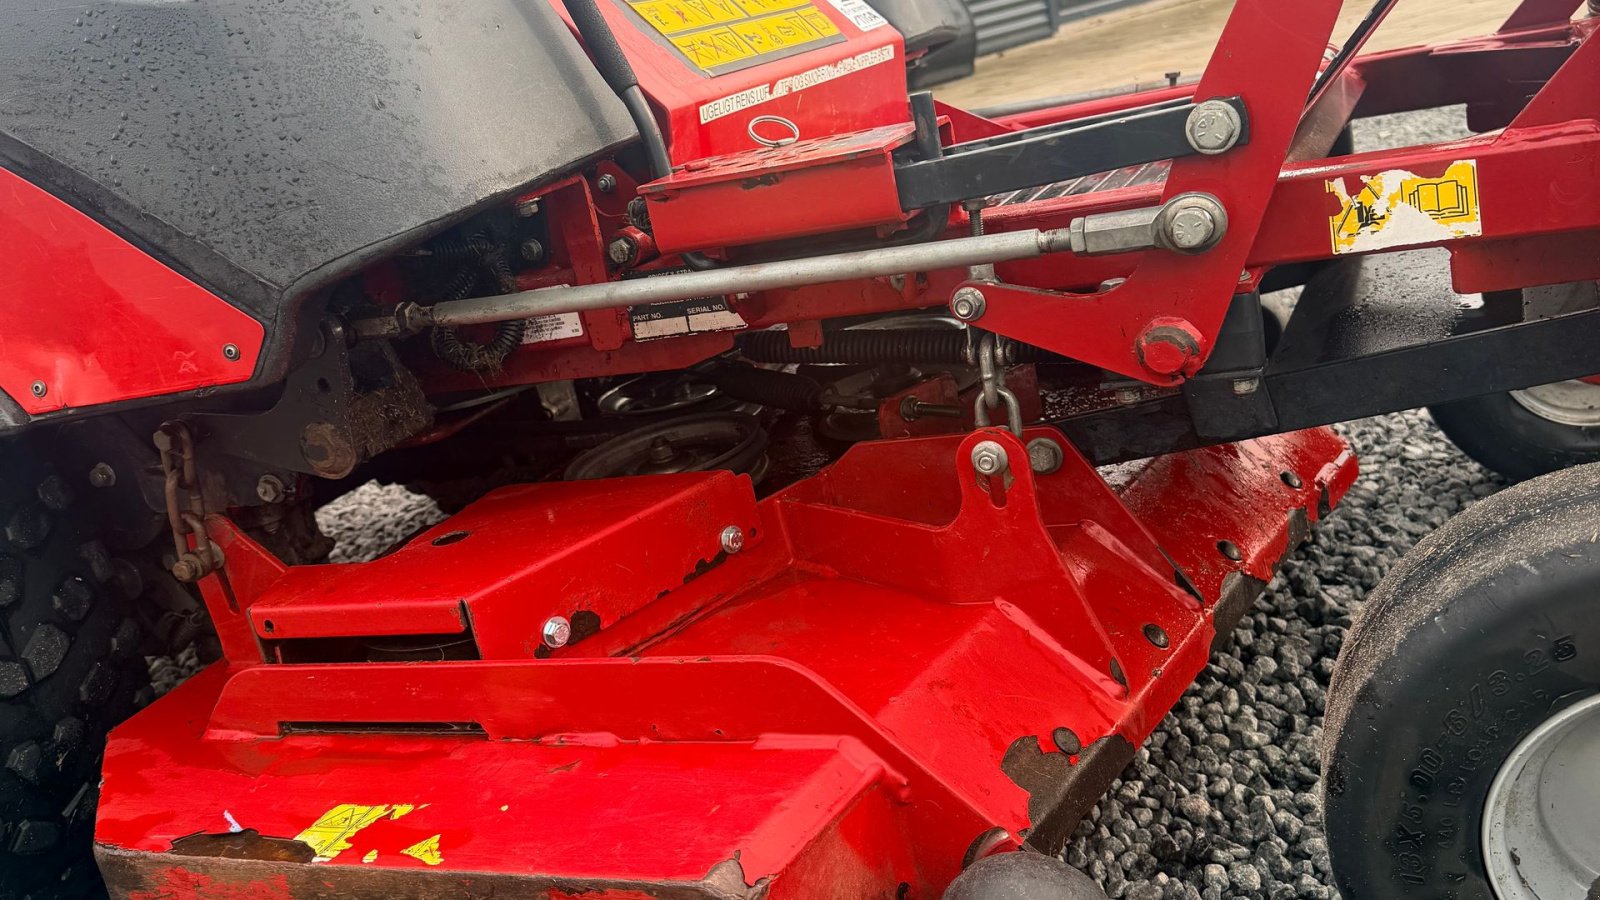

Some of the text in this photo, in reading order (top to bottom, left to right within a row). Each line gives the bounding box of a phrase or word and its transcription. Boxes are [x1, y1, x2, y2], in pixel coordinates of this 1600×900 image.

[735, 90, 756, 109] RENS
[686, 303, 725, 314] SERIAL NO.
[632, 313, 650, 321] PART
